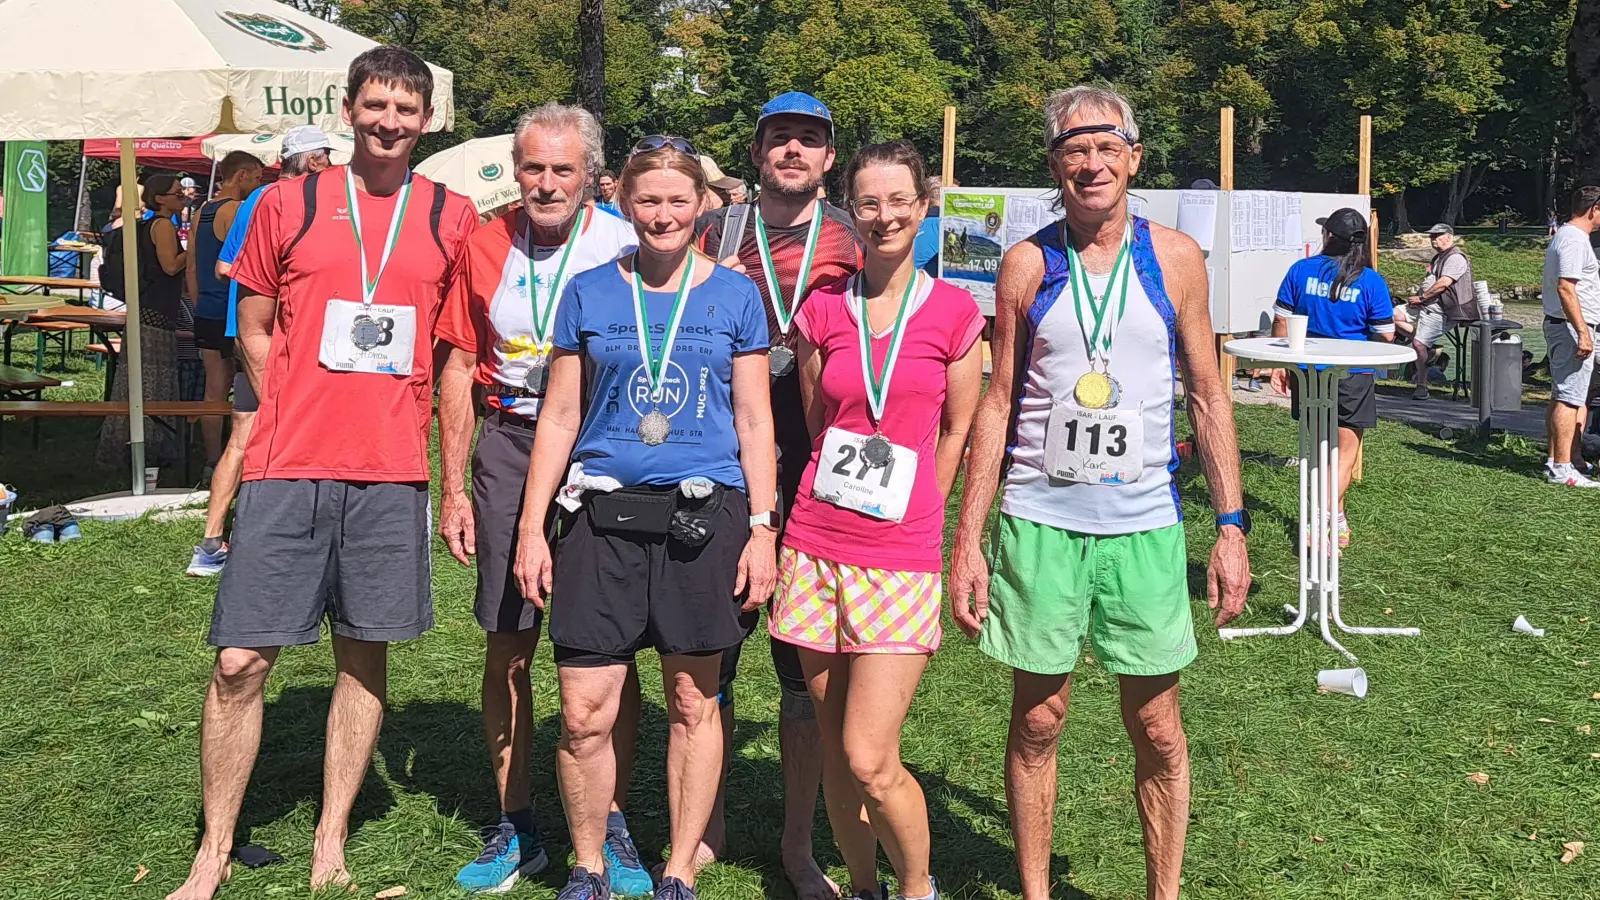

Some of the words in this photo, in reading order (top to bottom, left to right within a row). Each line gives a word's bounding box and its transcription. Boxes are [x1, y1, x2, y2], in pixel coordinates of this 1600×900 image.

[262, 84, 337, 125] Hopf
[151, 141, 182, 151] quattro
[477, 191, 499, 209] Hopf
[675, 345, 693, 353] DRS
[699, 366, 709, 392] 2023
[635, 385, 680, 404] RUN
[696, 394, 707, 419] MUC
[1076, 410, 1093, 419] ISAR
[1098, 413, 1118, 421] LAUF
[689, 430, 703, 438] STR
[1064, 418, 1128, 458] 113
[1056, 469, 1075, 479] PUMA
[843, 481, 874, 496] Caroline
